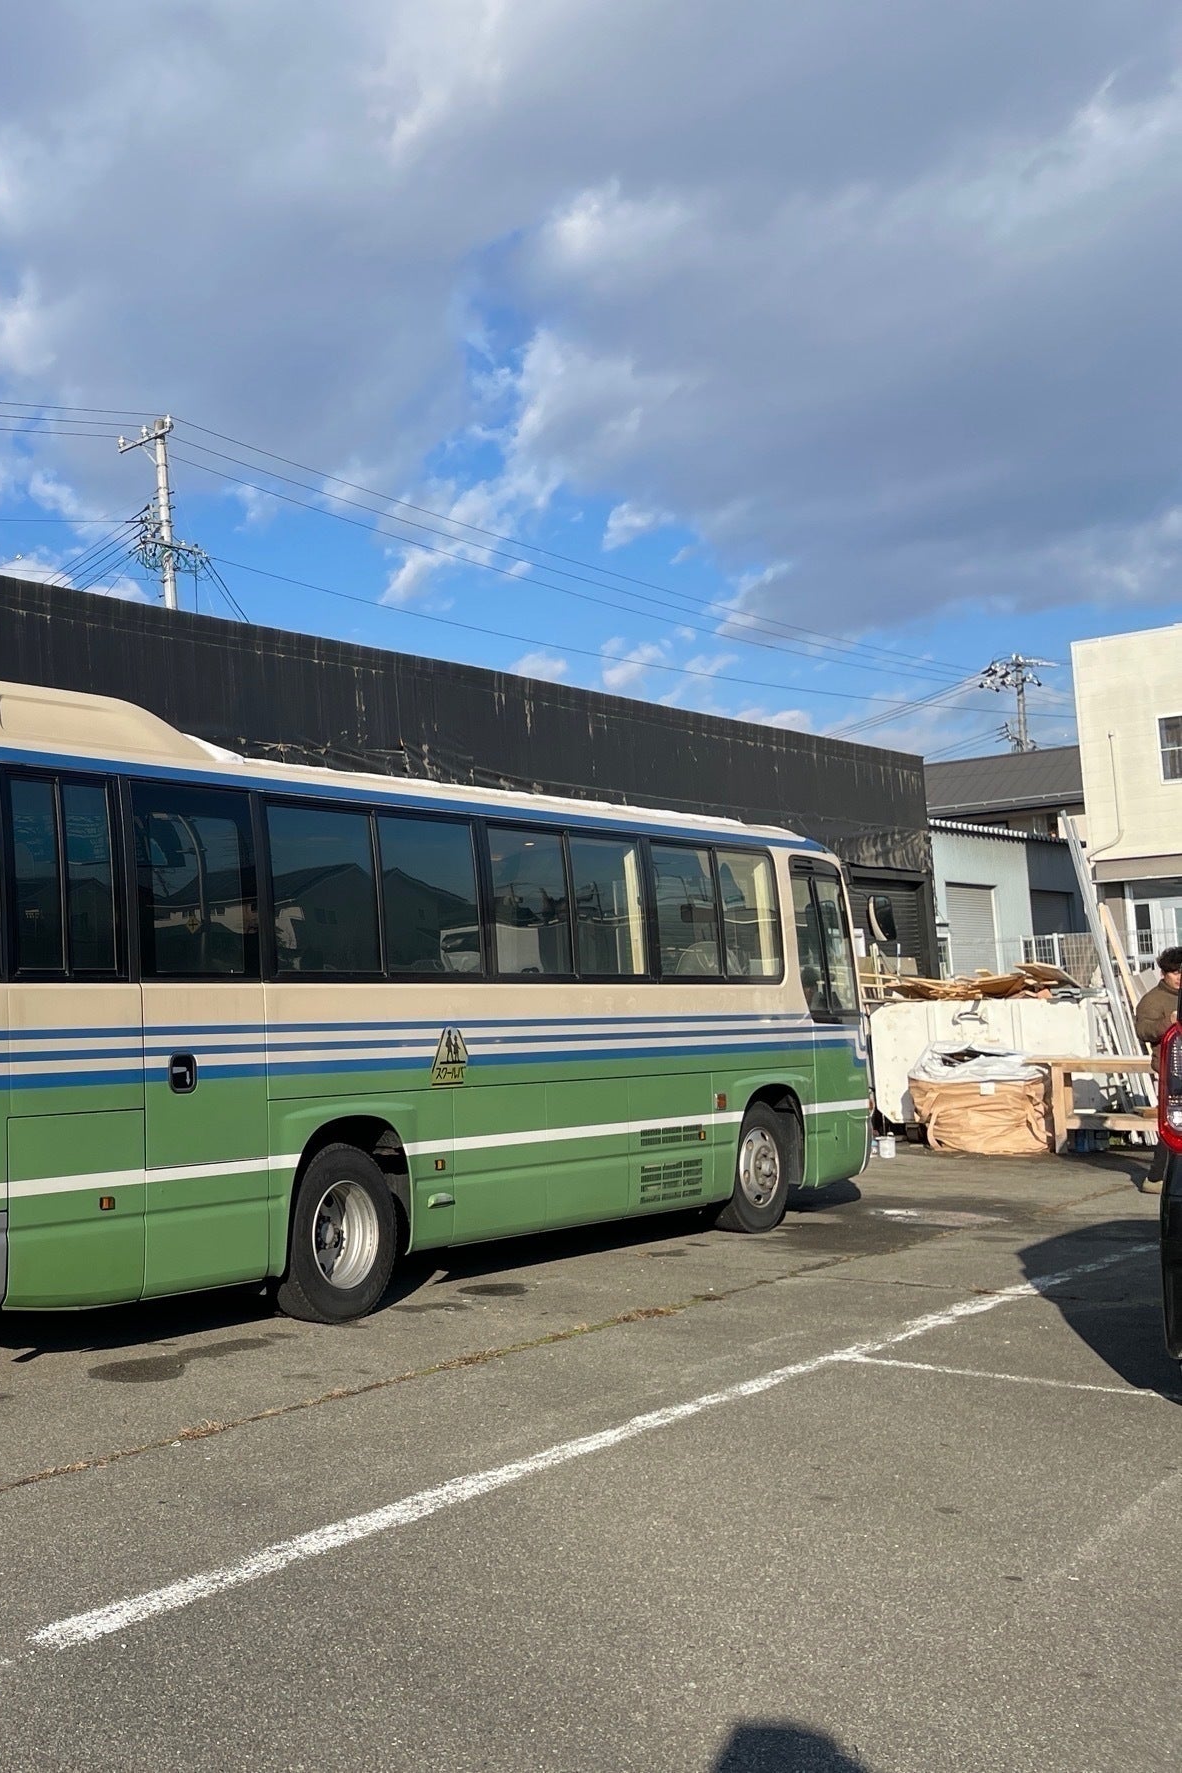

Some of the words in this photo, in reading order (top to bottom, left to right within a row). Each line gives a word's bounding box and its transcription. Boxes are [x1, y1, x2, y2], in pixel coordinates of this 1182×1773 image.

[435, 1066, 467, 1080] スクールバ
